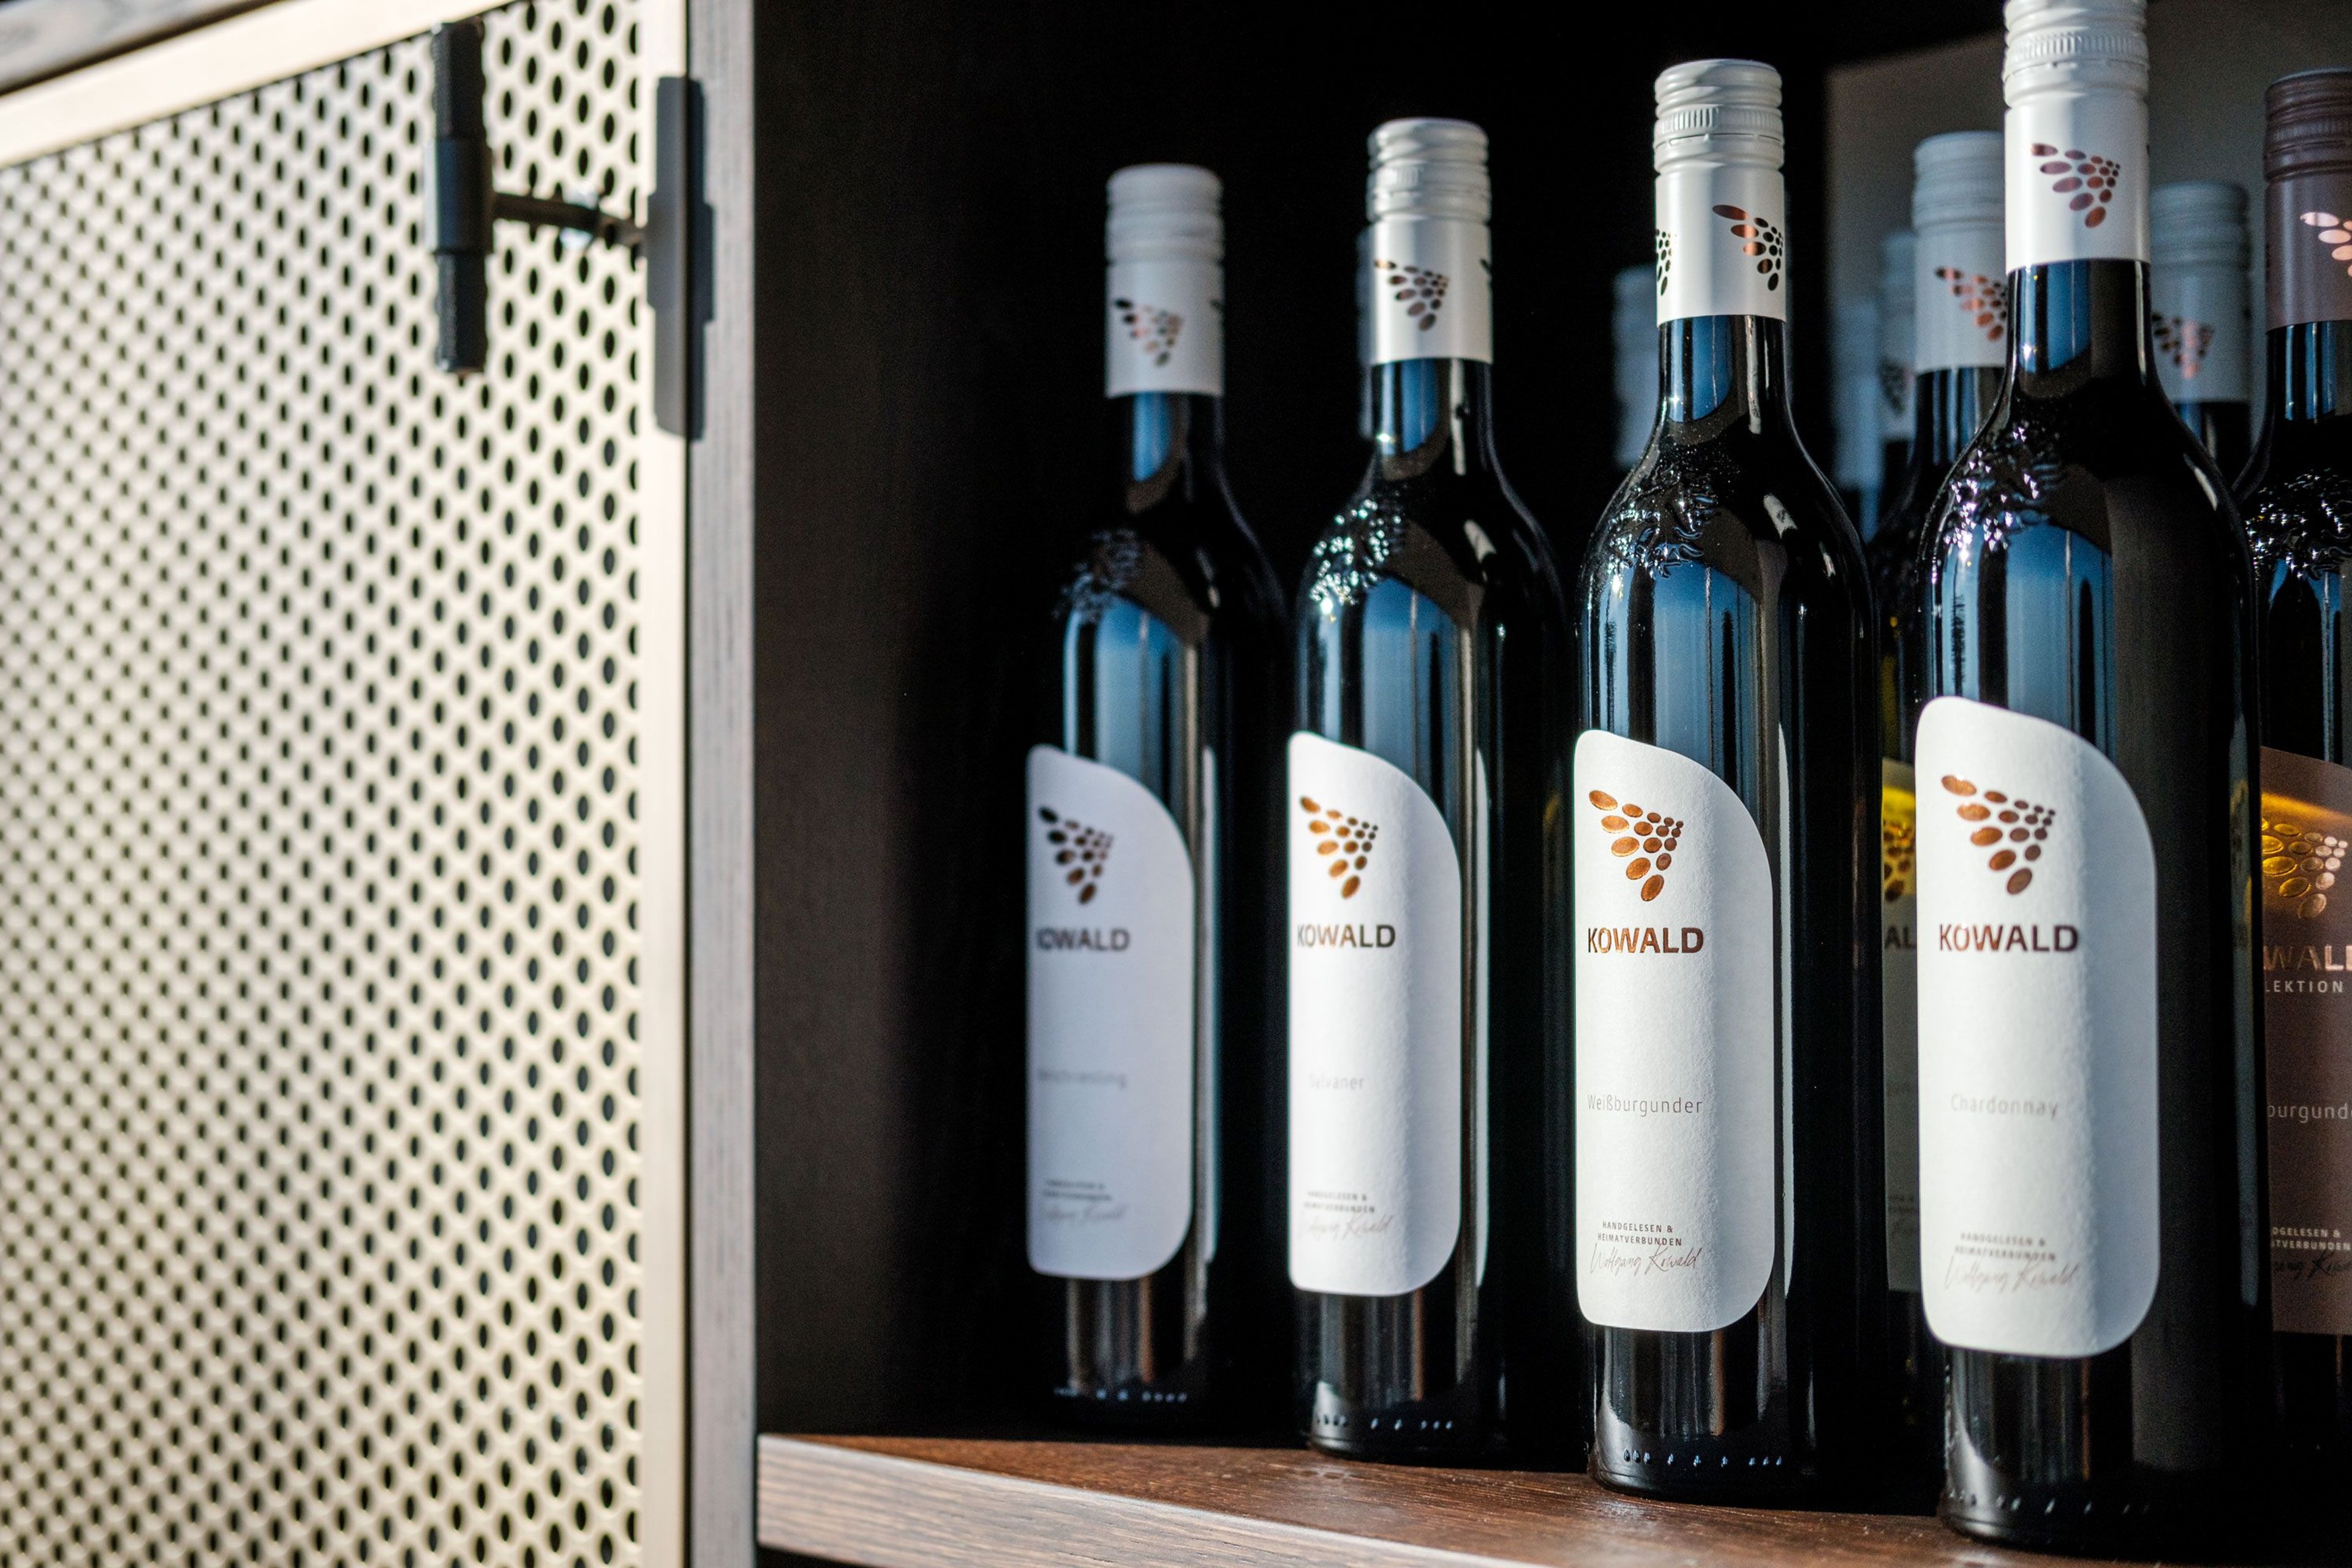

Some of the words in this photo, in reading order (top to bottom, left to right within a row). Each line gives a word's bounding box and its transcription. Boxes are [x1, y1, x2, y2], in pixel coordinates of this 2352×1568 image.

[1297, 924, 1396, 948] KOWALD
[1588, 927, 1704, 954] KOWALD
[1939, 924, 2079, 952] KOWALD
[1588, 1093, 1703, 1117] Weißburgunder
[1951, 1093, 2057, 1120] Chardonnay
[2267, 1103, 2352, 1123] urgund
[1602, 1221, 1662, 1233] HANDGELESEN
[1597, 1233, 1682, 1246] HEIMATVERBUNDEN
[1645, 1244, 1703, 1275] Kowald
